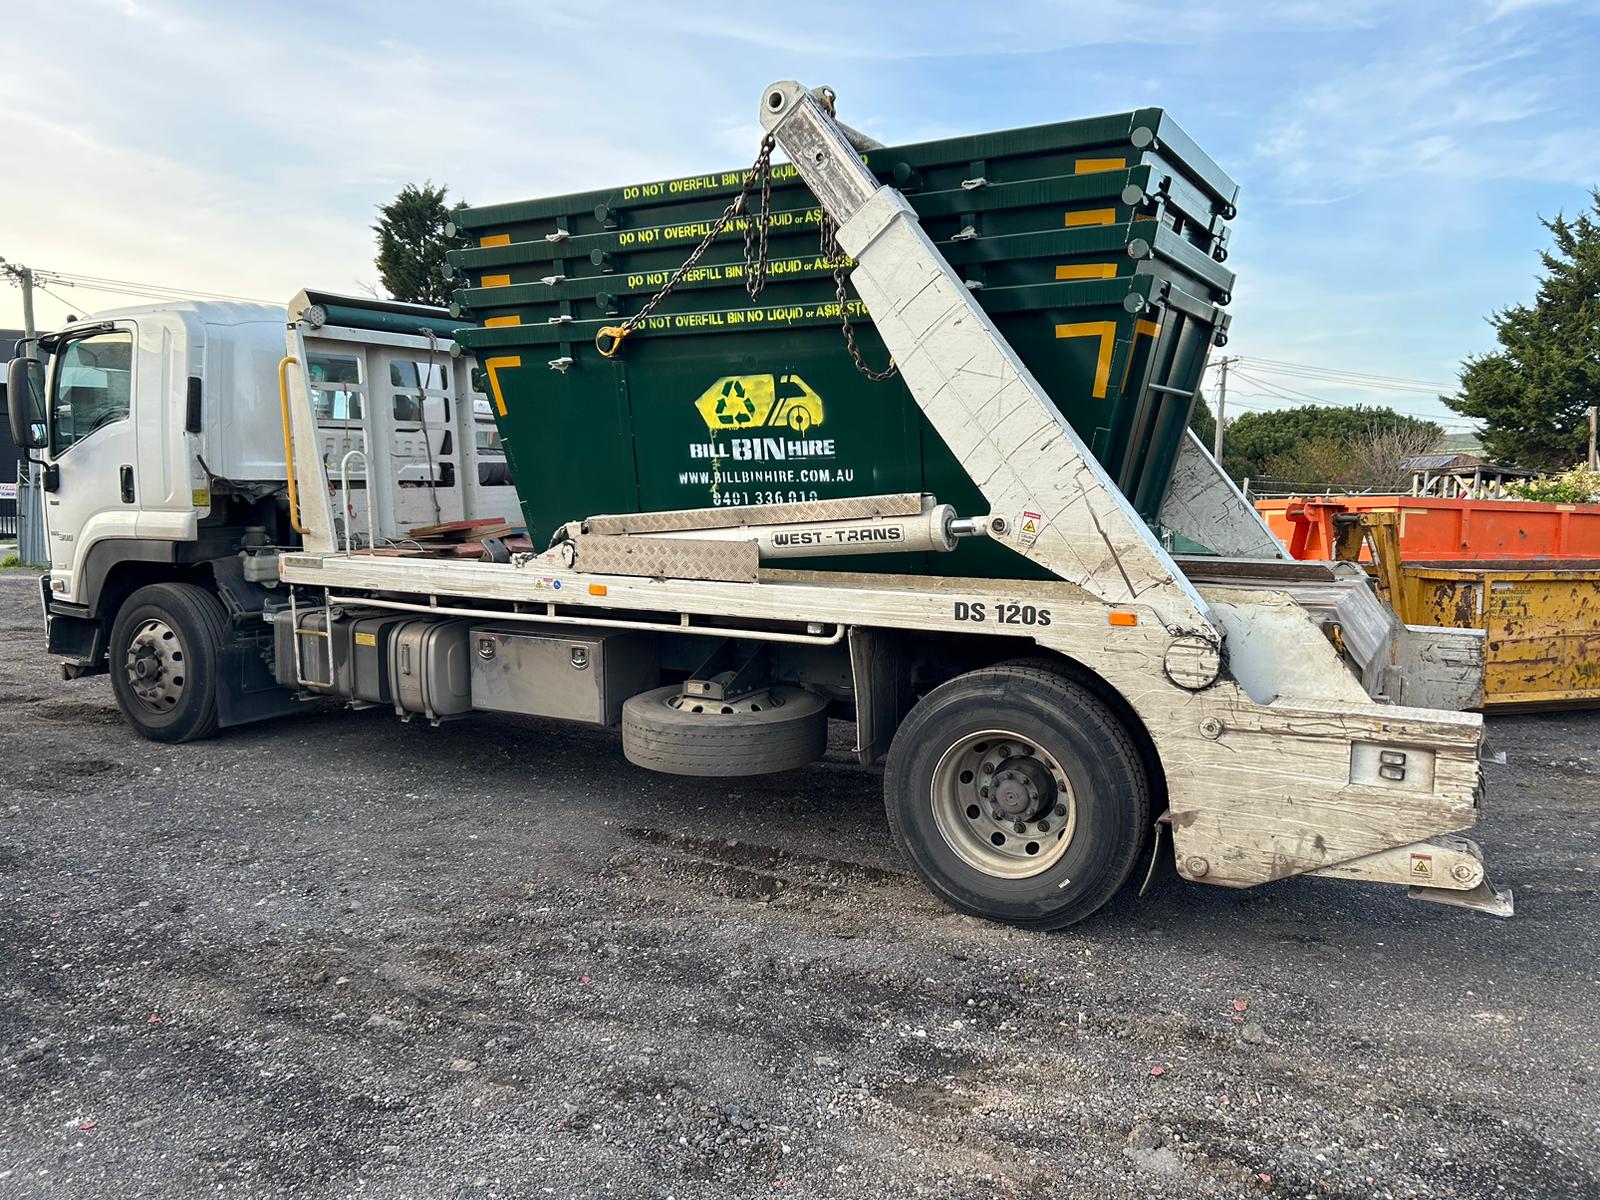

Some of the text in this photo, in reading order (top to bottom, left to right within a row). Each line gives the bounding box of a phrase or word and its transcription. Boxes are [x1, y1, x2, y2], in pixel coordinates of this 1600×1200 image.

[623, 187, 640, 200] DO
[642, 183, 665, 197] NOT
[669, 176, 718, 193] OVERFILL
[721, 172, 739, 186] BIN
[619, 233, 635, 246] DO
[638, 229, 660, 243] NOT
[664, 222, 714, 239] OVERFILL
[718, 220, 734, 232] IN
[794, 216, 804, 224] or
[628, 275, 644, 288] DO
[646, 271, 669, 285] NOT
[672, 266, 722, 282] VERFILL
[725, 265, 743, 278] BIN
[765, 259, 802, 275] LIQUID
[804, 262, 813, 271] or
[649, 316, 672, 329] NOT
[675, 312, 724, 327] OVERFILL
[727, 311, 744, 324] BIN
[747, 310, 764, 321] NO
[767, 307, 804, 324] LIQUID
[805, 309, 814, 318] or
[689, 437, 836, 461] BILL BIN HIRE
[678, 469, 854, 485] WWW.BILLBINHIRE.COM.AU
[713, 491, 749, 506] 0401
[755, 490, 784, 505] 336
[954, 601, 1052, 626] DS 120s
